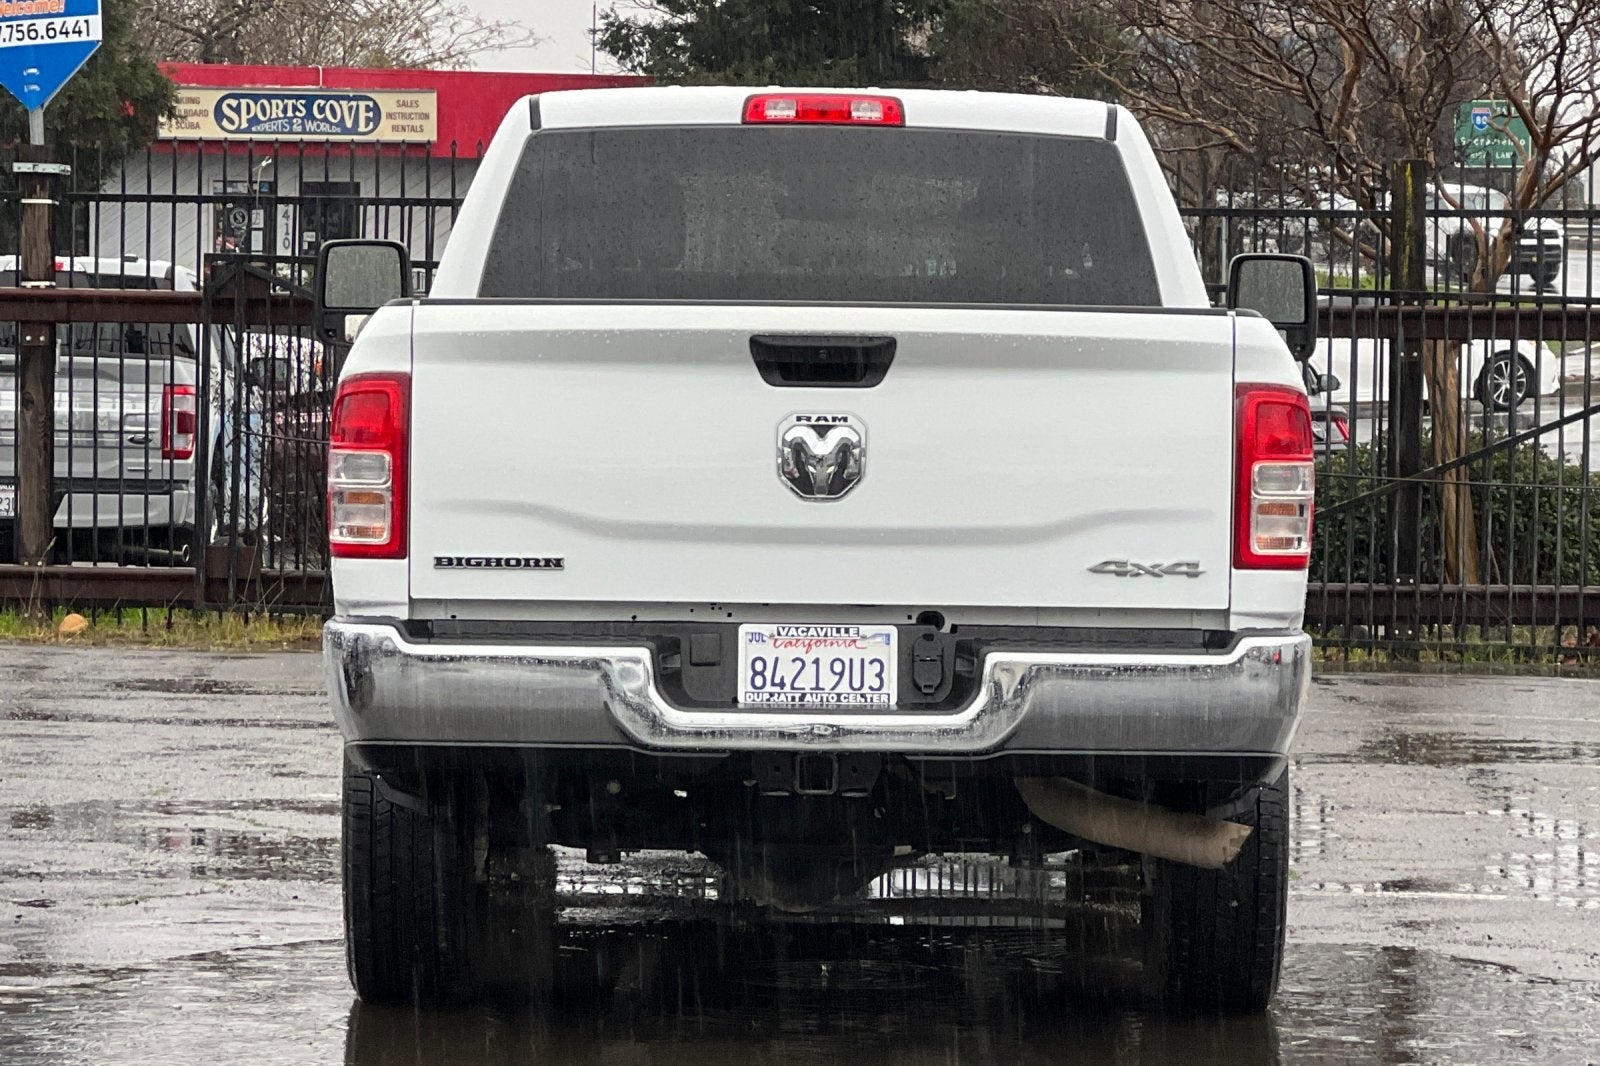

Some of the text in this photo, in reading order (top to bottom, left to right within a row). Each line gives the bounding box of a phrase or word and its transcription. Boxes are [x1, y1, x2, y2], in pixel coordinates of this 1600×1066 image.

[0, 19, 90, 43] .756.6441
[396, 100, 420, 108] SALES
[221, 98, 374, 132] SPORTS COVE
[386, 112, 430, 120] INSTRUCTION
[175, 121, 201, 130] SCUBA
[1476, 116, 1488, 125] 80
[391, 125, 424, 133] RENTALS
[795, 415, 849, 423] RAM
[433, 556, 565, 569] BIGHORN
[778, 626, 859, 638] VACAVILLE
[748, 633, 766, 643] JUL
[773, 638, 868, 654] California
[750, 656, 886, 692] 84219U3
[804, 693, 837, 703] AUTO
[840, 694, 889, 704] CENTER
